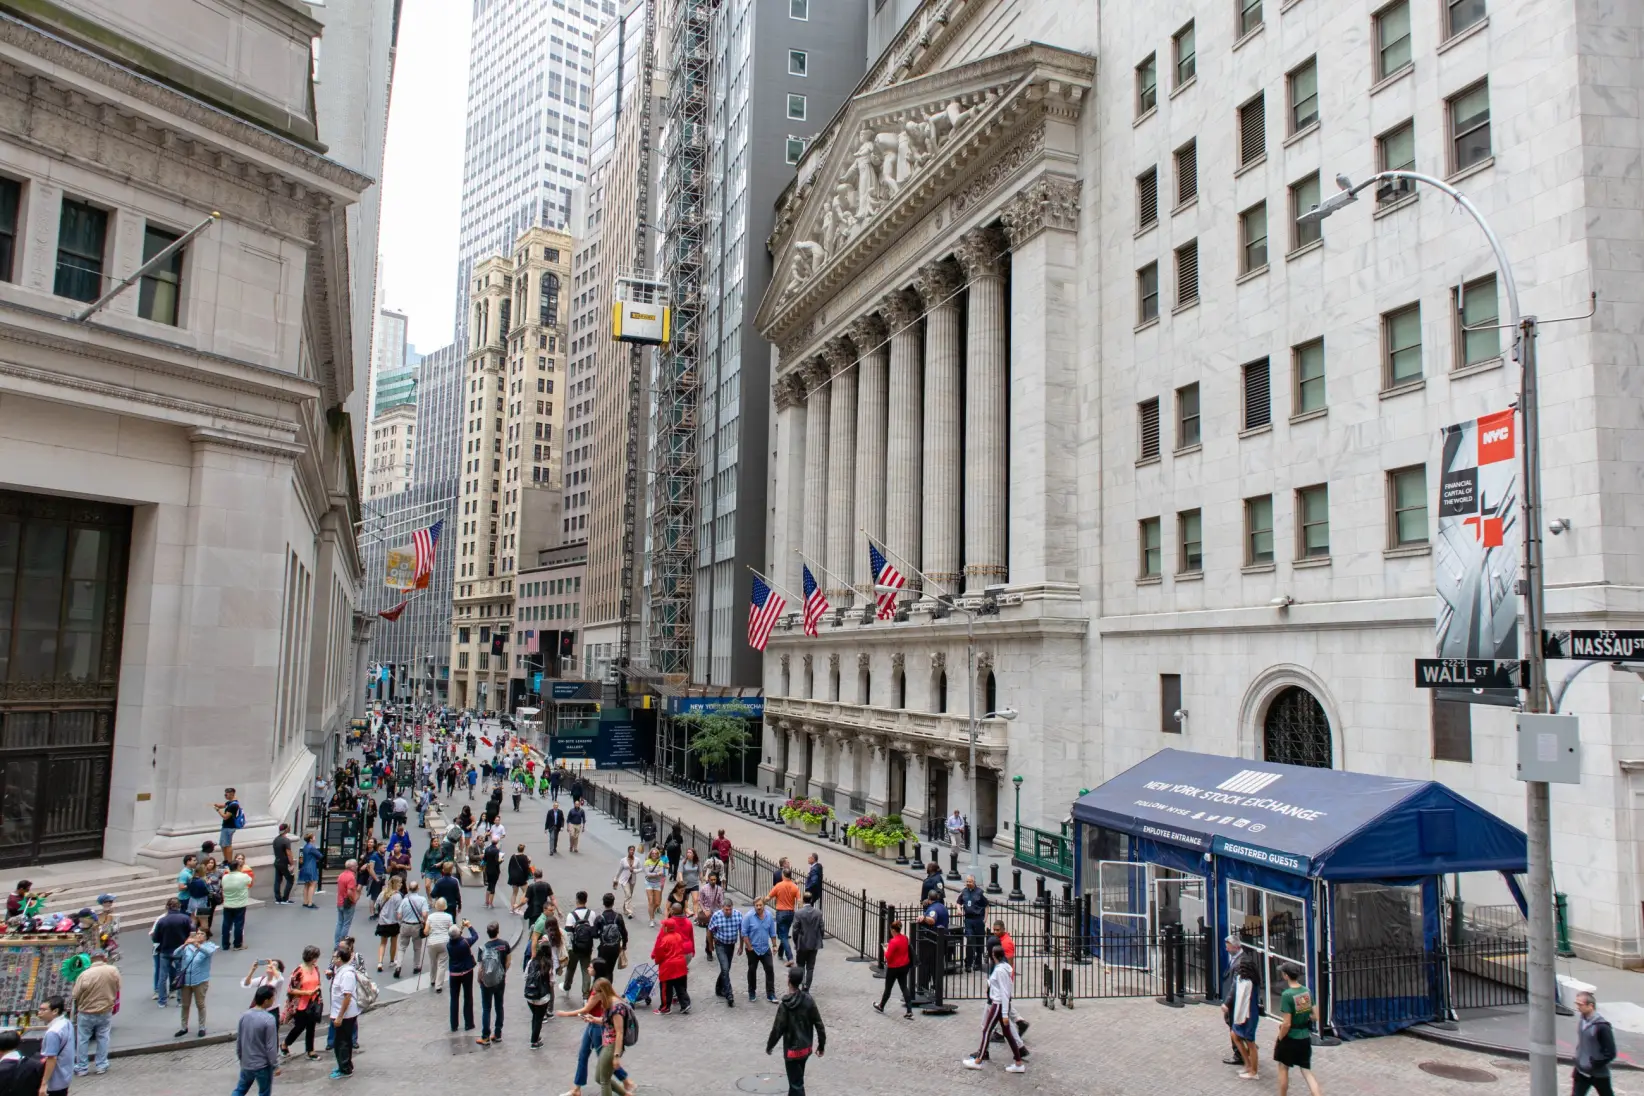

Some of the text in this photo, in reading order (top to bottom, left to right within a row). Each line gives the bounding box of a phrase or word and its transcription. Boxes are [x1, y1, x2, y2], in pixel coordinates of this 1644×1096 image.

[1483, 426, 1509, 445] NYC
[1444, 480, 1472, 490] FINANCIAL
[1444, 489, 1465, 498] CAPITAL
[1444, 496, 1473, 505] THE WORLD
[1573, 638, 1644, 656] NASSAU ST
[1423, 666, 1488, 683] WALL ST
[1133, 799, 1191, 816] FOLLOW NYSE
[1143, 780, 1321, 821] NEW YORK STOCK EXCHANGE
[1143, 825, 1202, 846] EMPLOYEE ENTRANCE
[1223, 842, 1299, 868] REGISTERED GUESTS
